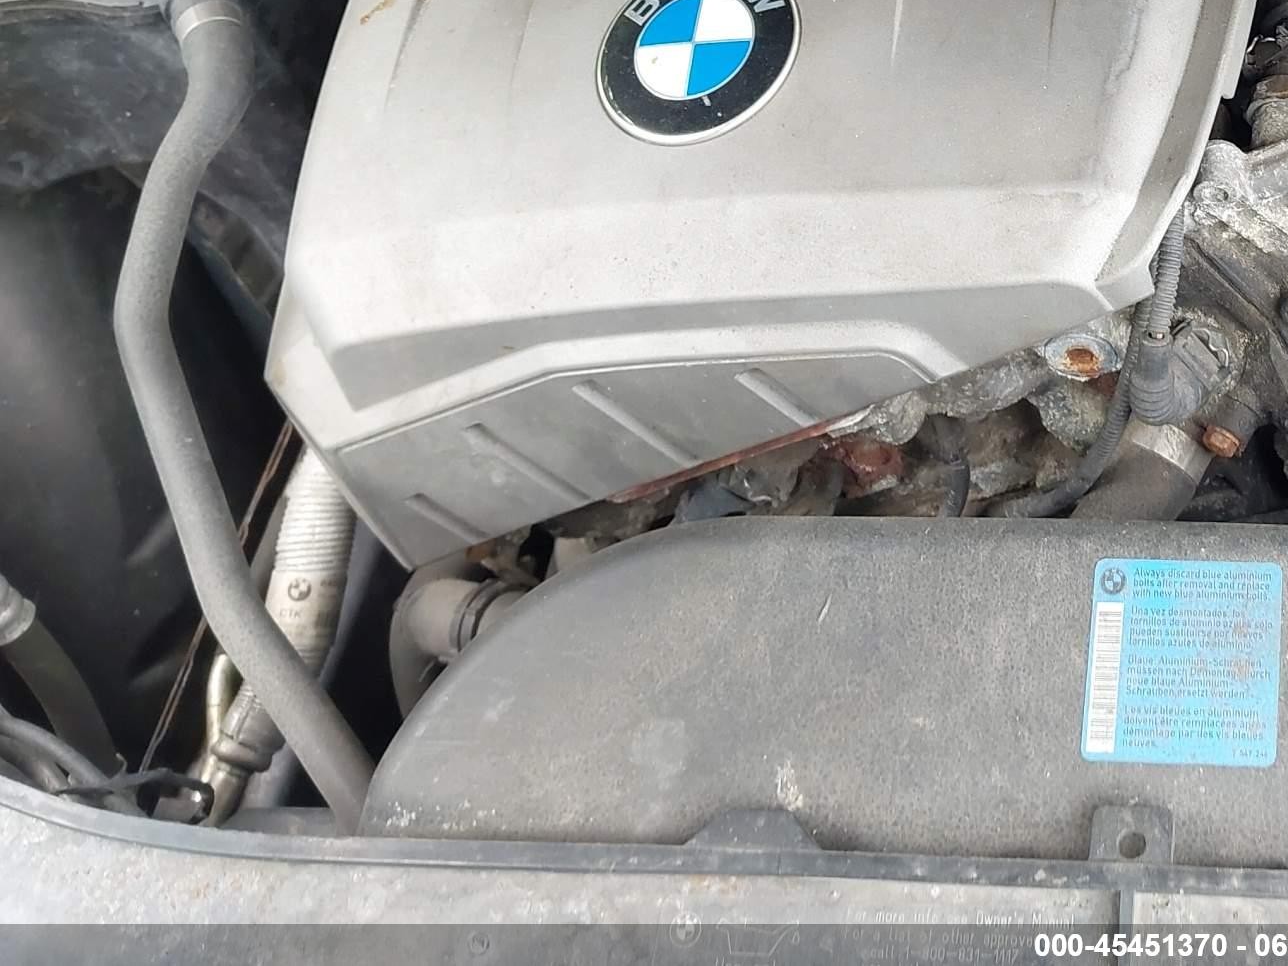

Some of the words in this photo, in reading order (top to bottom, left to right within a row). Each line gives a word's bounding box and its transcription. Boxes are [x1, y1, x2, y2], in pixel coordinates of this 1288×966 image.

[1135, 568, 1165, 579] Always
[1168, 569, 1200, 579] discard
[1202, 570, 1221, 579] blue
[1224, 570, 1272, 581] aluminium
[1156, 578, 1176, 588] after
[1180, 579, 1216, 589] removal
[1219, 580, 1235, 590] and
[1237, 581, 1270, 592] replace
[1132, 588, 1151, 598] with
[1153, 590, 1172, 598] new
[1175, 589, 1194, 599] blue
[1197, 590, 1243, 600] aluminium
[1150, 607, 1166, 616] vez
[1169, 617, 1180, 626] de
[1214, 629, 1229, 640] por
[1199, 639, 1210, 648] de
[1165, 666, 1187, 676] nach
[1143, 705, 1157, 715] vis
